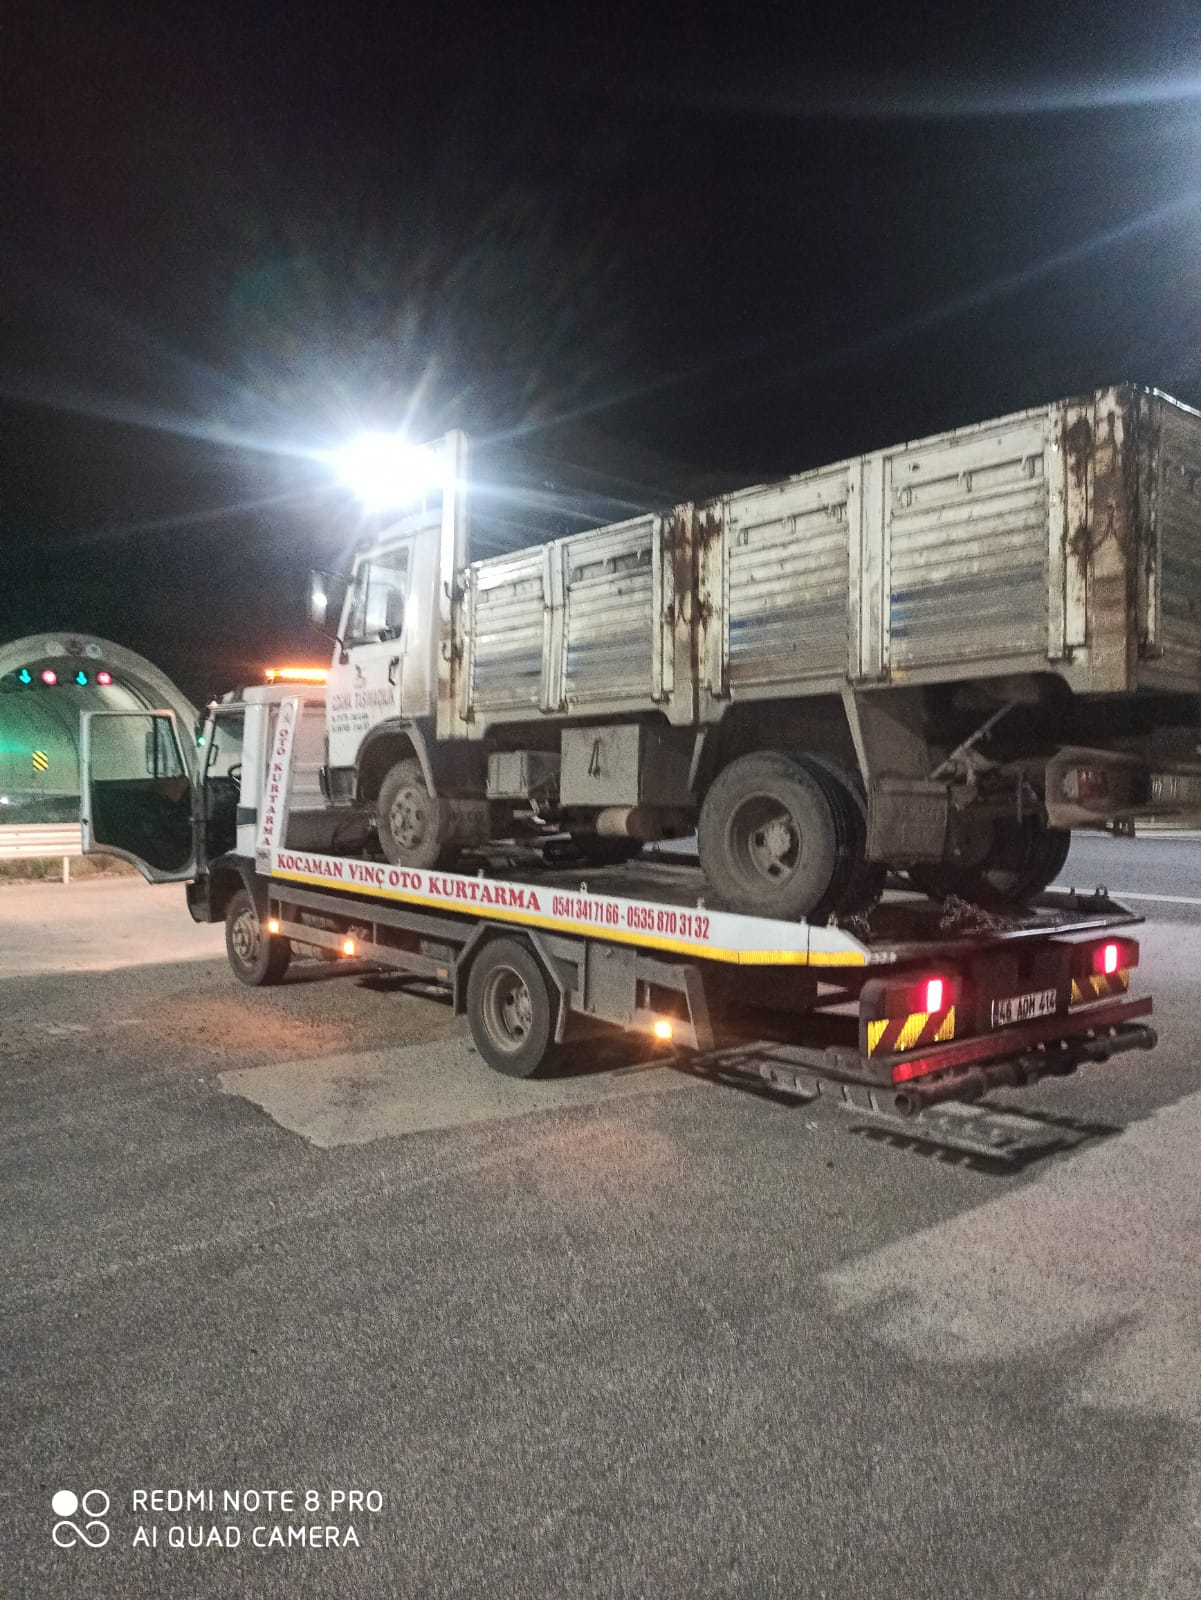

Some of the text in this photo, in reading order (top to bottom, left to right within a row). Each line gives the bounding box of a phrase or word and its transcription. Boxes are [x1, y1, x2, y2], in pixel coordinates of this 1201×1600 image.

[277, 729, 289, 756] OTO
[263, 762, 283, 847] KURTARMA
[277, 854, 343, 878] KOCAMAN
[389, 870, 423, 890] OTO
[429, 877, 541, 912] KURTARMA
[552, 895, 574, 918] 0541
[576, 898, 592, 921] 341
[605, 903, 619, 925] 66
[627, 905, 655, 930] 0535
[657, 910, 677, 934] 870
[679, 913, 692, 936] 31
[694, 915, 710, 939] 32
